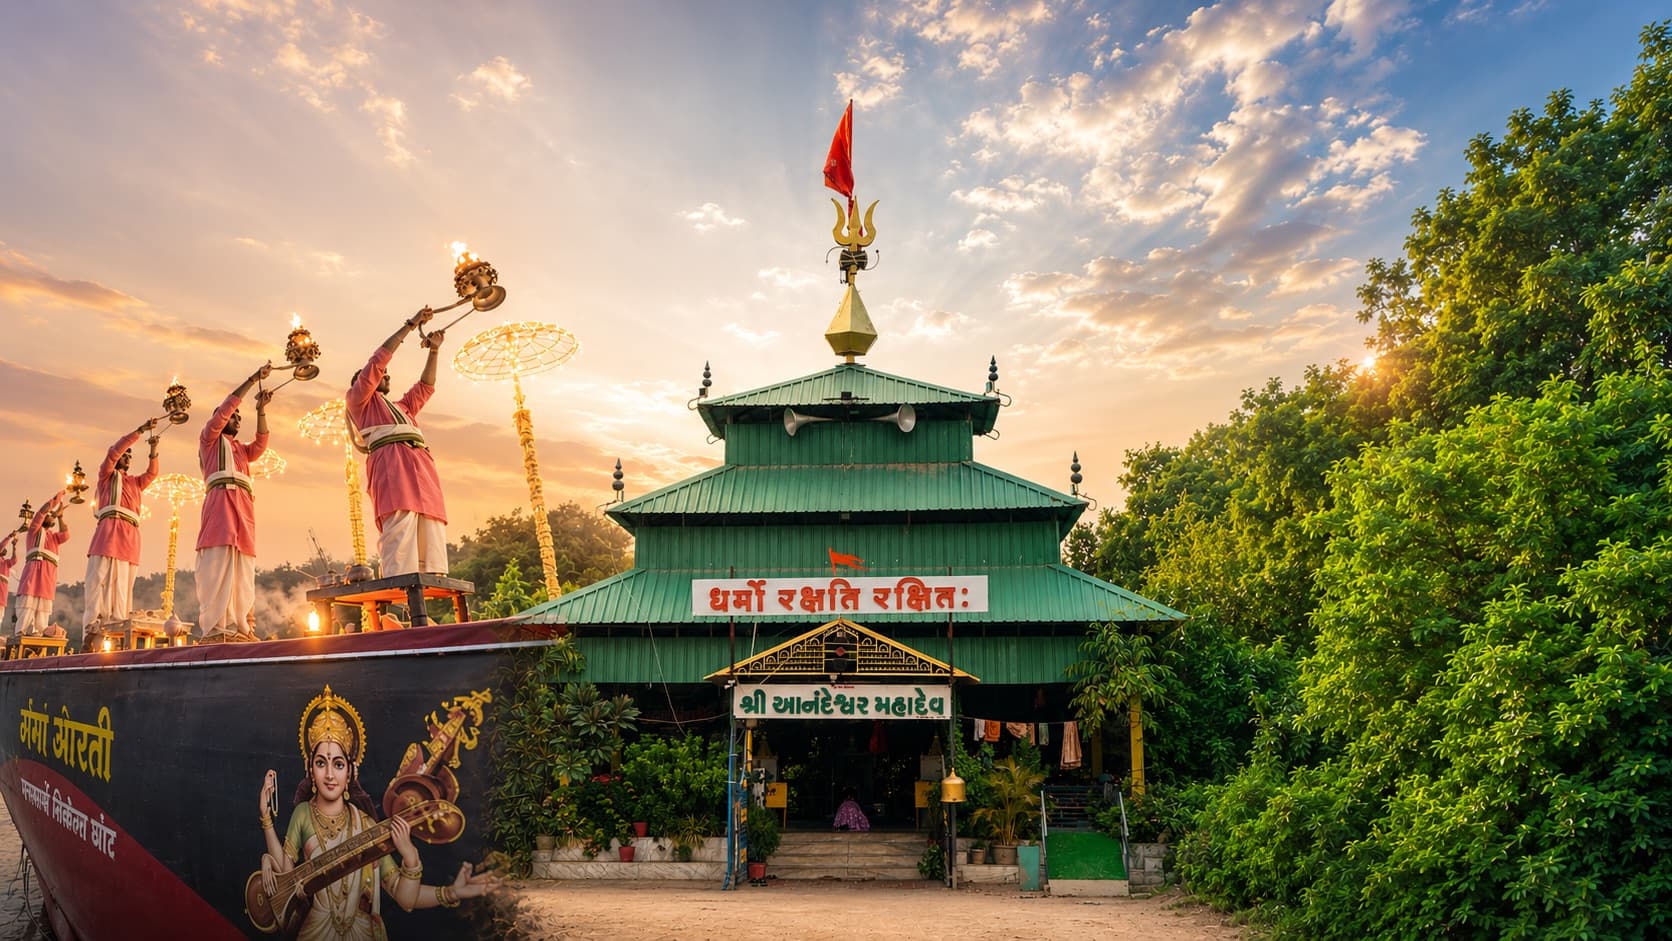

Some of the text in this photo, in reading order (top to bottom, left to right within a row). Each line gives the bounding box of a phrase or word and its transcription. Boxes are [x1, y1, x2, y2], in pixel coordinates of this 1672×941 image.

[709, 579, 767, 612] धर्मो
[778, 579, 861, 613] रक्षति
[739, 687, 945, 718] શ્રી આનંદેશ્વર મહાદેવ
